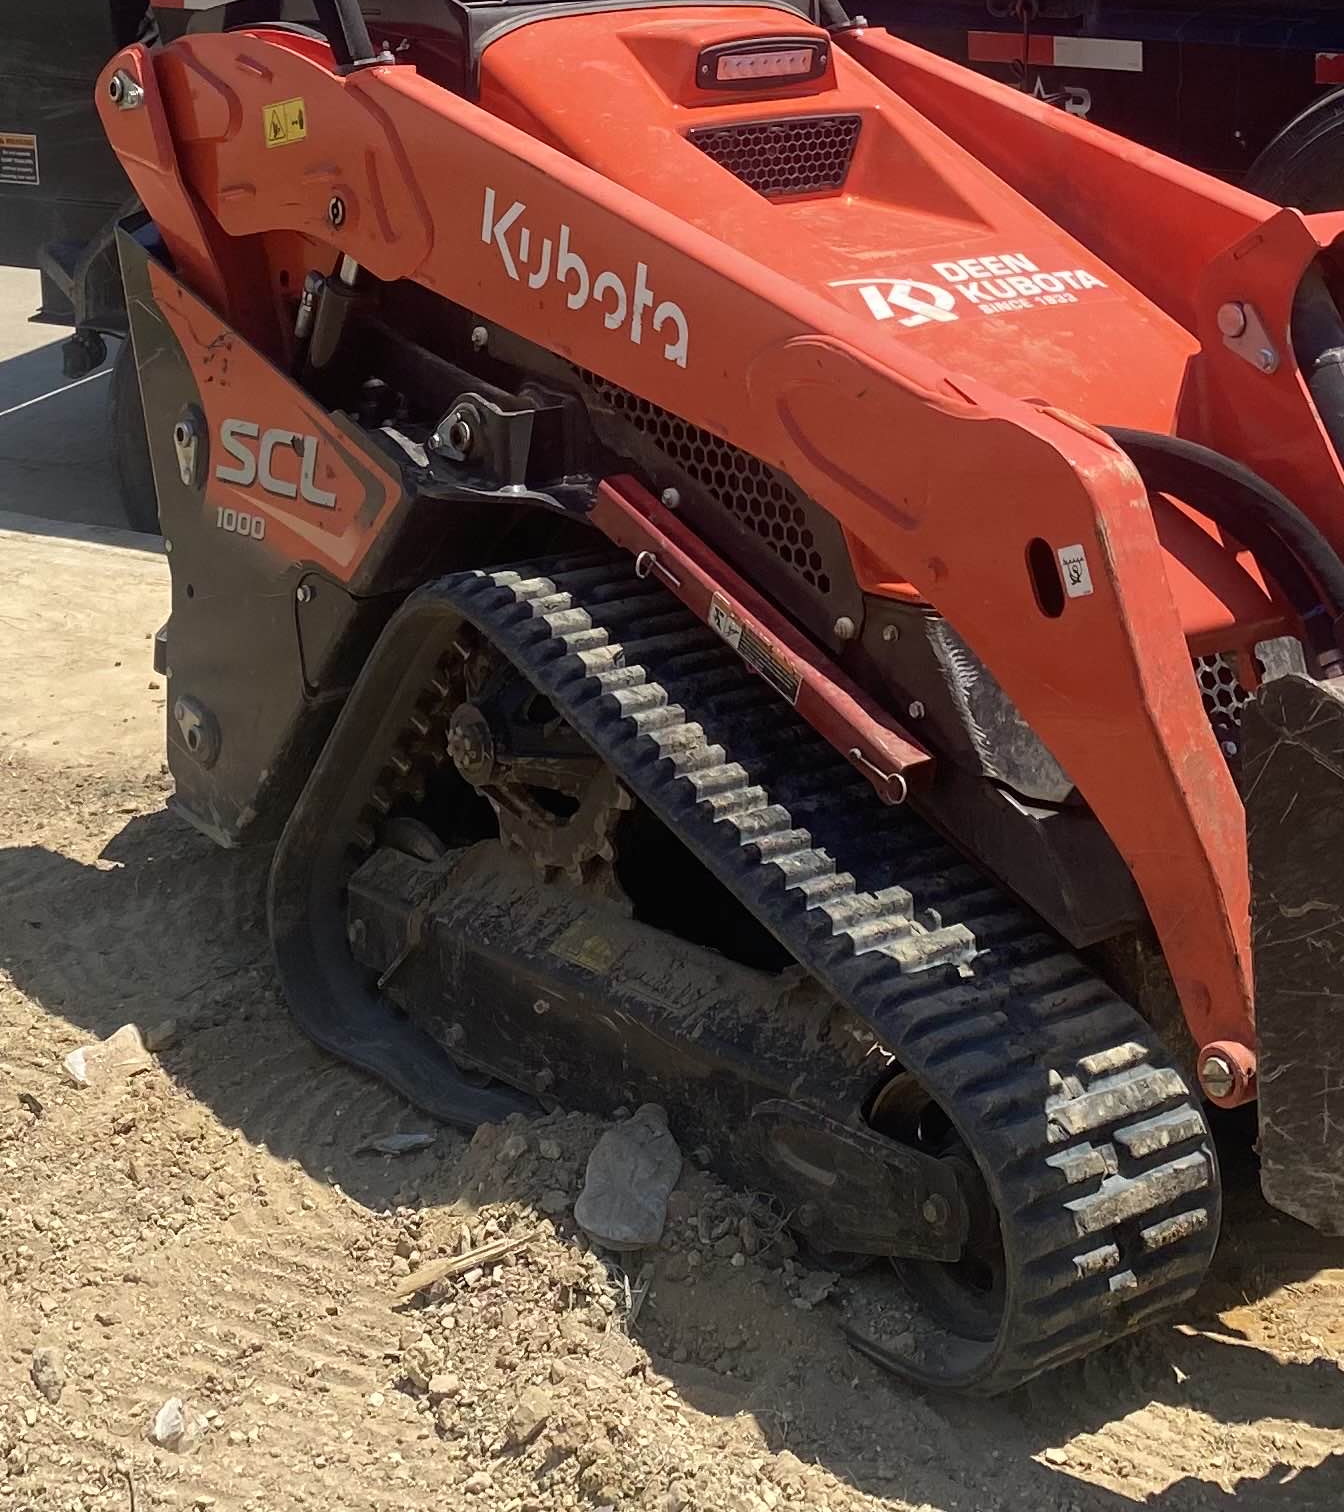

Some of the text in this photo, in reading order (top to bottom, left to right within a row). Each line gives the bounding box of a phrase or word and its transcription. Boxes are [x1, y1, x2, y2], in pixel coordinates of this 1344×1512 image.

[481, 187, 689, 368] Kubota
[931, 253, 1040, 283] DEEN
[955, 269, 1109, 304] KUBOTA
[977, 298, 1034, 315] SINCE
[216, 418, 336, 508] SCL
[217, 507, 265, 541] 1000
